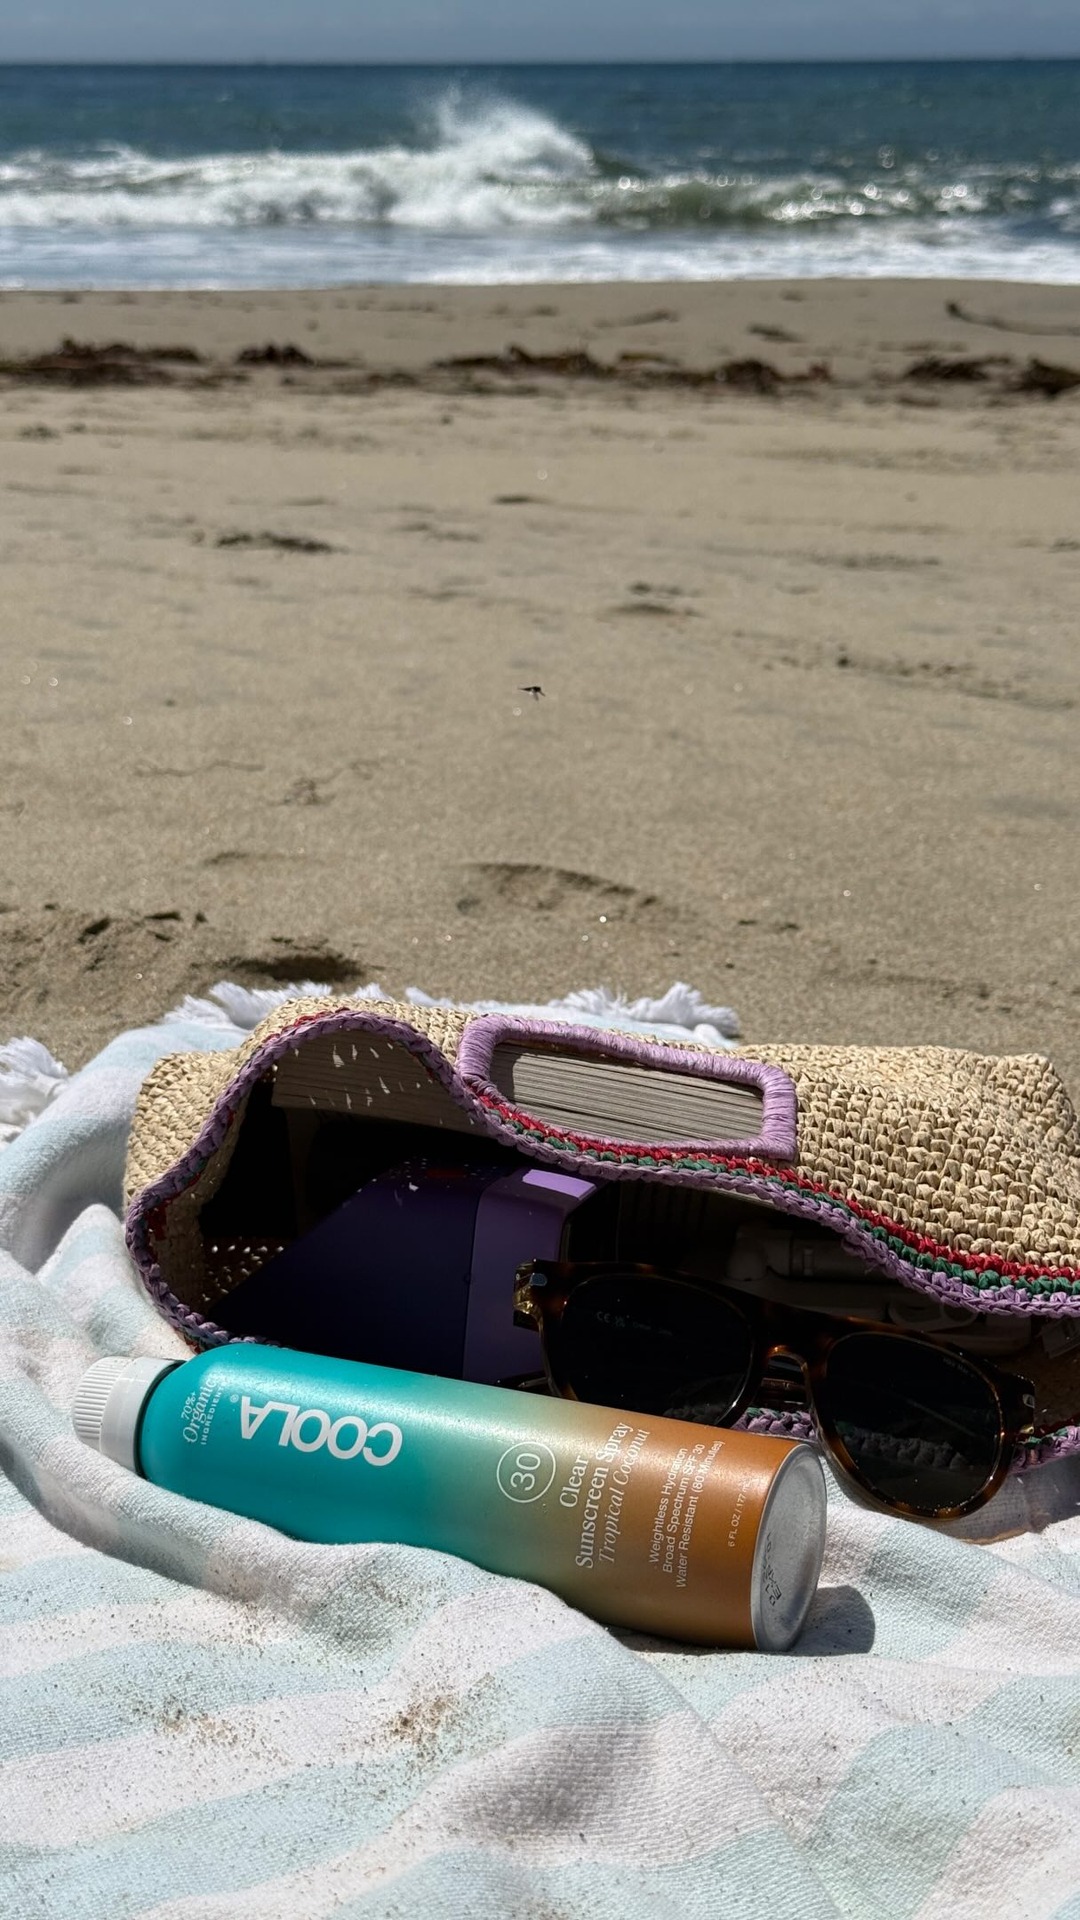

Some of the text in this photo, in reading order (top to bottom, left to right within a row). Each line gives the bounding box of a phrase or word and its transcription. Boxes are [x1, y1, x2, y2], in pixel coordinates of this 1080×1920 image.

[182, 1378, 217, 1443] Organic
[240, 1395, 403, 1466] COOLA
[510, 1452, 541, 1491] 30
[559, 1455, 589, 1508] Clear
[575, 1422, 633, 1569] Sunscreen Spray
[598, 1429, 651, 1563] Tropical Coconut
[649, 1448, 688, 1563] Weightless Hydration
[662, 1442, 706, 1574] Broad Spectrum SPF 30
[675, 1440, 726, 1589] Water Resistant (80 Minutes)
[729, 1529, 738, 1540] FL
[732, 1513, 741, 1528] OZ
